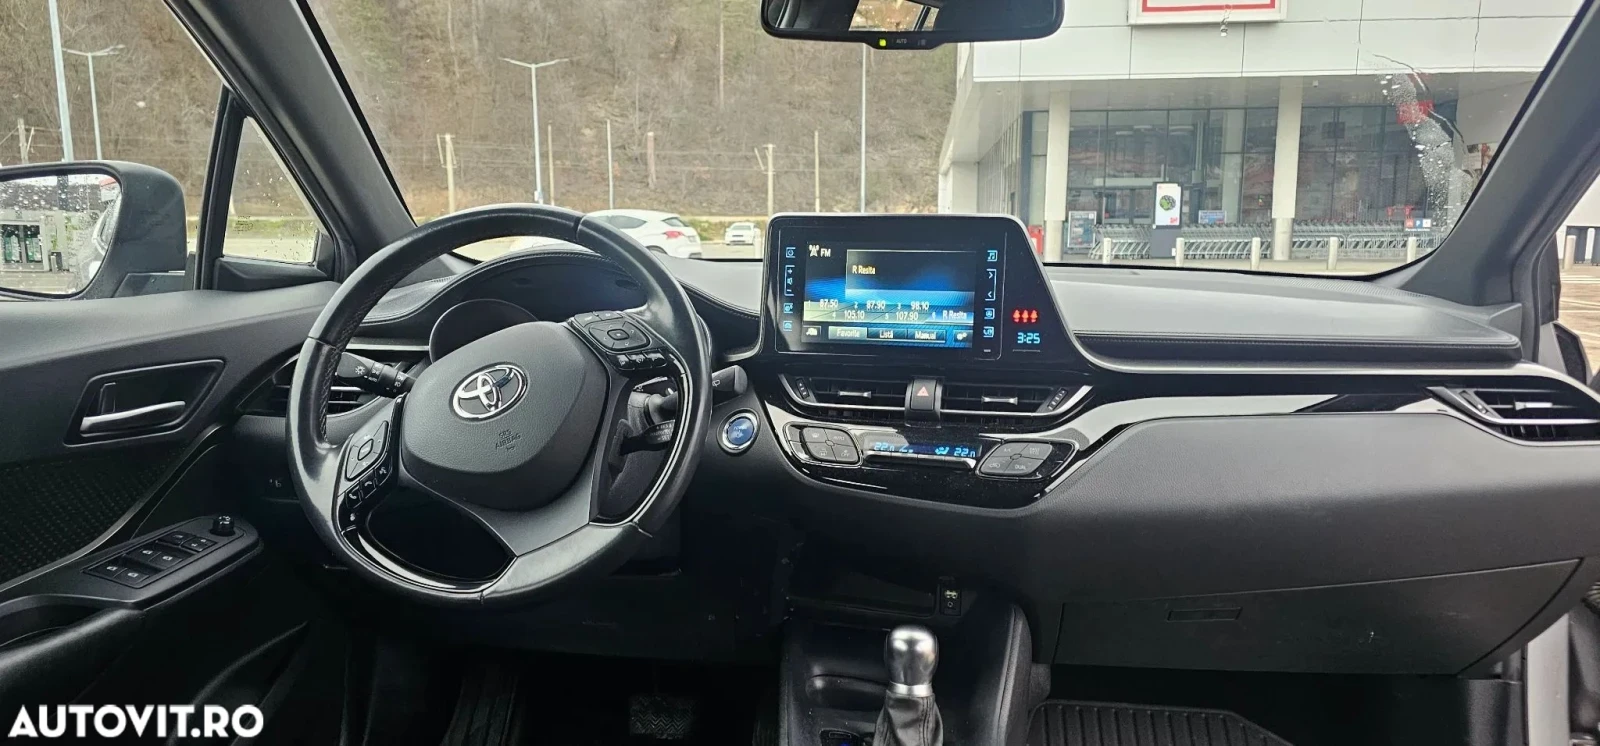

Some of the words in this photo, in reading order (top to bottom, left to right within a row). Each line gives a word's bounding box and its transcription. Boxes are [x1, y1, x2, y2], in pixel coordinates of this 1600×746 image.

[820, 248, 831, 257] FM
[852, 264, 858, 274] R
[819, 298, 839, 308] 87.50
[866, 300, 886, 310] 87.90
[910, 301, 930, 311] 98.10
[844, 310, 865, 319] 105.10
[895, 311, 919, 321] 107.90
[942, 309, 948, 319] R
[914, 330, 937, 340] Manual
[1017, 332, 1041, 344] 3:25
